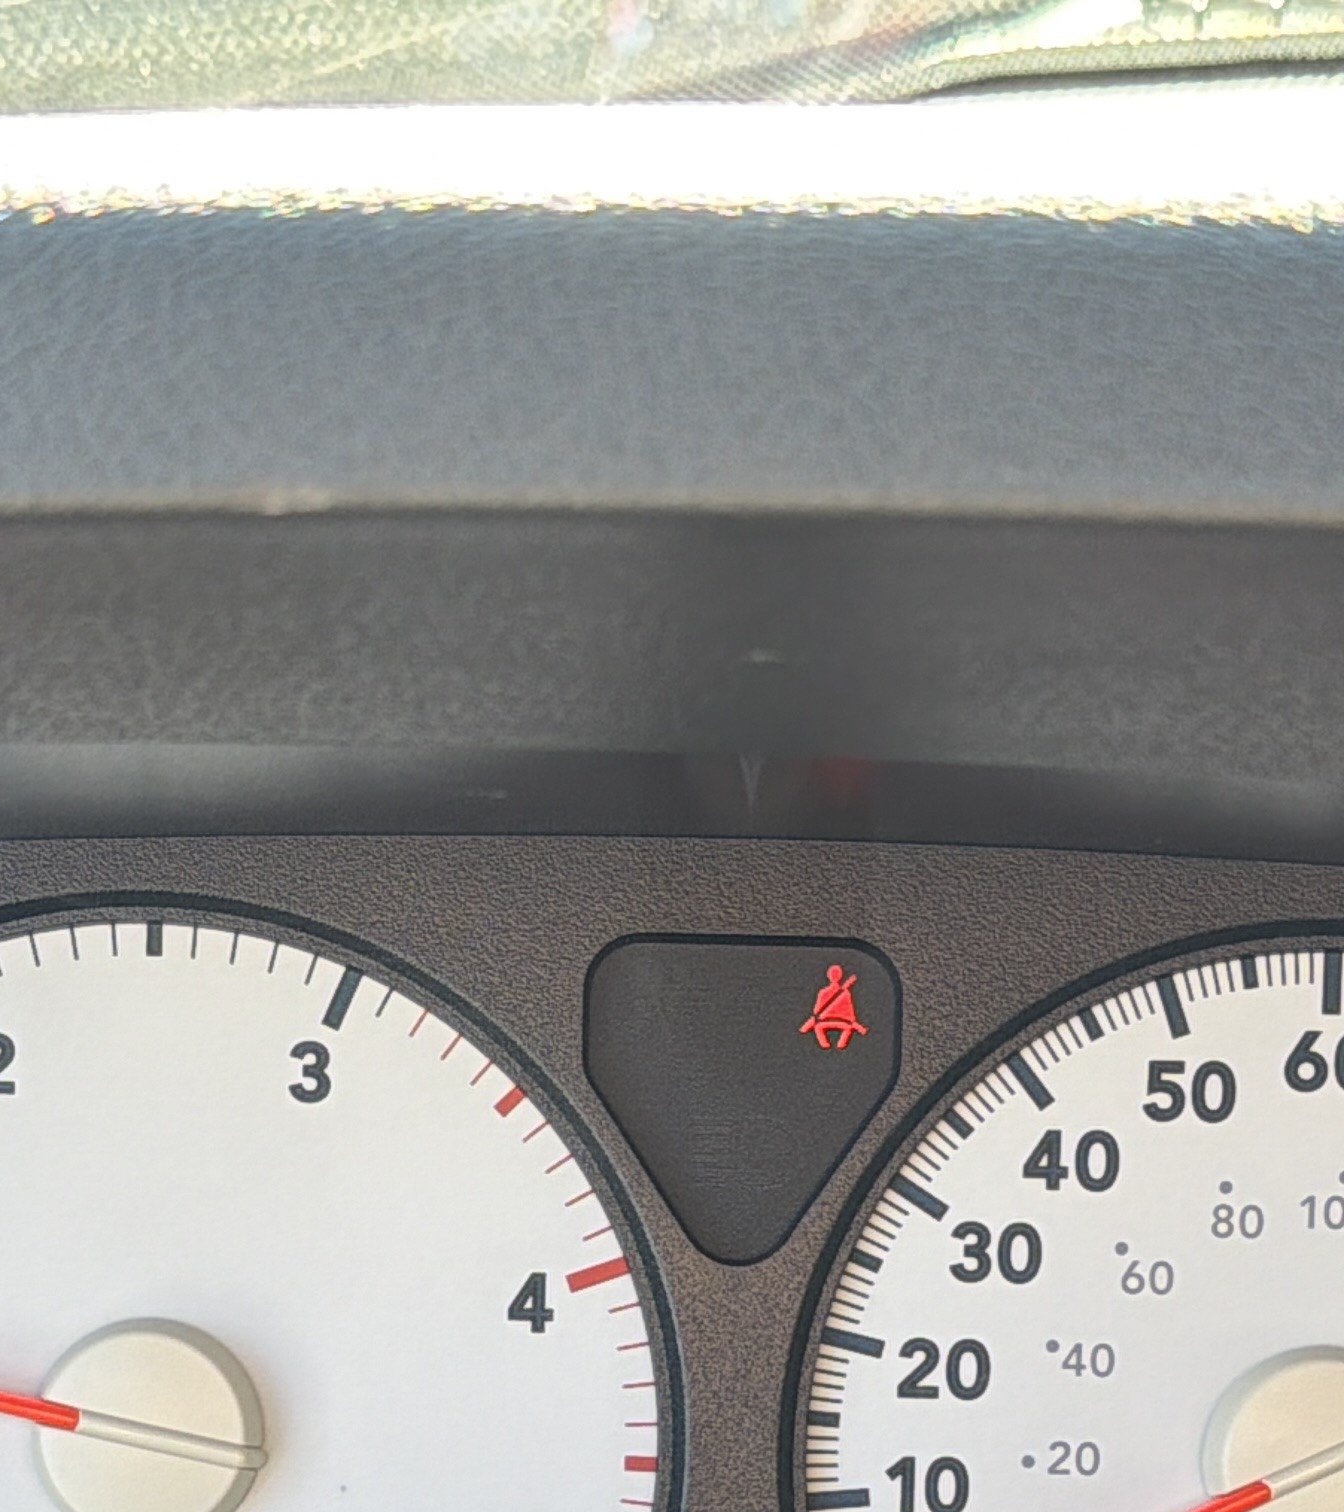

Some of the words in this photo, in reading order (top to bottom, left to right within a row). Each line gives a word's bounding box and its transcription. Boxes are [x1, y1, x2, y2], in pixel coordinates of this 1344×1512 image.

[288, 1041, 331, 1103] 3
[1142, 1059, 1237, 1123] 50
[1023, 1129, 1121, 1192] 40
[1211, 1203, 1265, 1239] 80
[949, 1221, 1042, 1284] 30
[1121, 1260, 1174, 1295] 60
[507, 1272, 554, 1333] 4
[897, 1338, 991, 1400] 20
[1062, 1343, 1115, 1377] 40
[1047, 1441, 1100, 1476] 20
